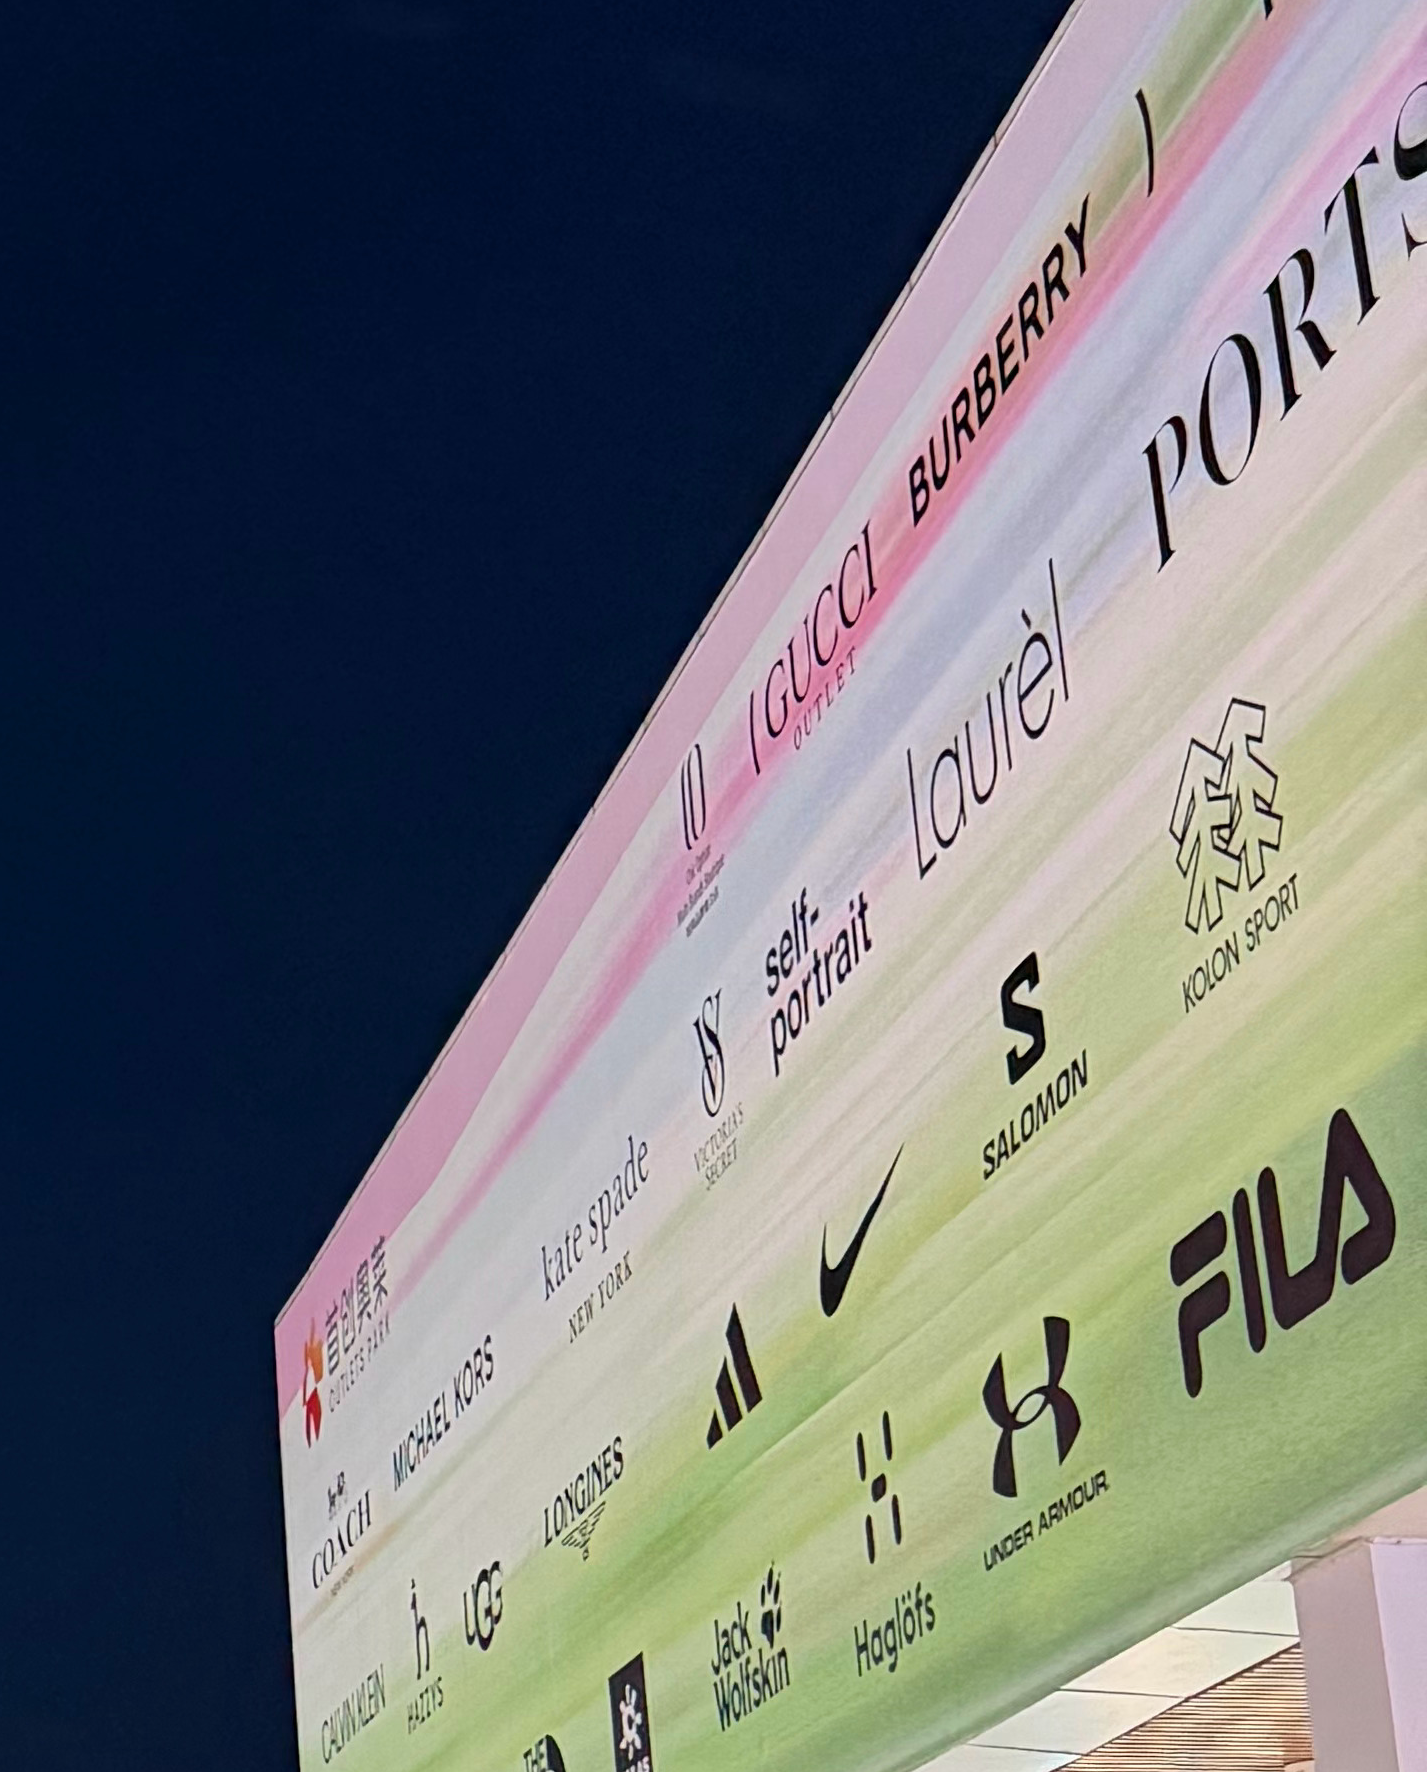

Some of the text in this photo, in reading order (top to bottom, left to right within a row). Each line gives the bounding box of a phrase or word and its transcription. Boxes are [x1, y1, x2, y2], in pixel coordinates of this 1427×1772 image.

[907, 193, 1092, 527] BURBERRY
[764, 520, 878, 740] GUCCI
[792, 645, 858, 751] OUTLET
[766, 886, 820, 998] self-
[769, 890, 873, 1078] portrait
[1181, 872, 1300, 1014] KOLON SPORT
[982, 1048, 1090, 1181] SALOMON
[541, 1134, 649, 1301] kate spade
[1169, 1107, 1397, 1399] FILA
[568, 1251, 634, 1344] NEW YORK
[392, 1334, 495, 1492] MICHAEL KORS
[312, 1488, 372, 1590] COACH
[543, 1435, 625, 1549] LONGINES
[982, 1468, 1111, 1572] UNDER ARMOUR
[463, 1560, 504, 1651] UGG
[711, 1600, 750, 1677] Jack
[853, 1580, 936, 1679] Haglöfs
[712, 1645, 792, 1733] Wolfskin
